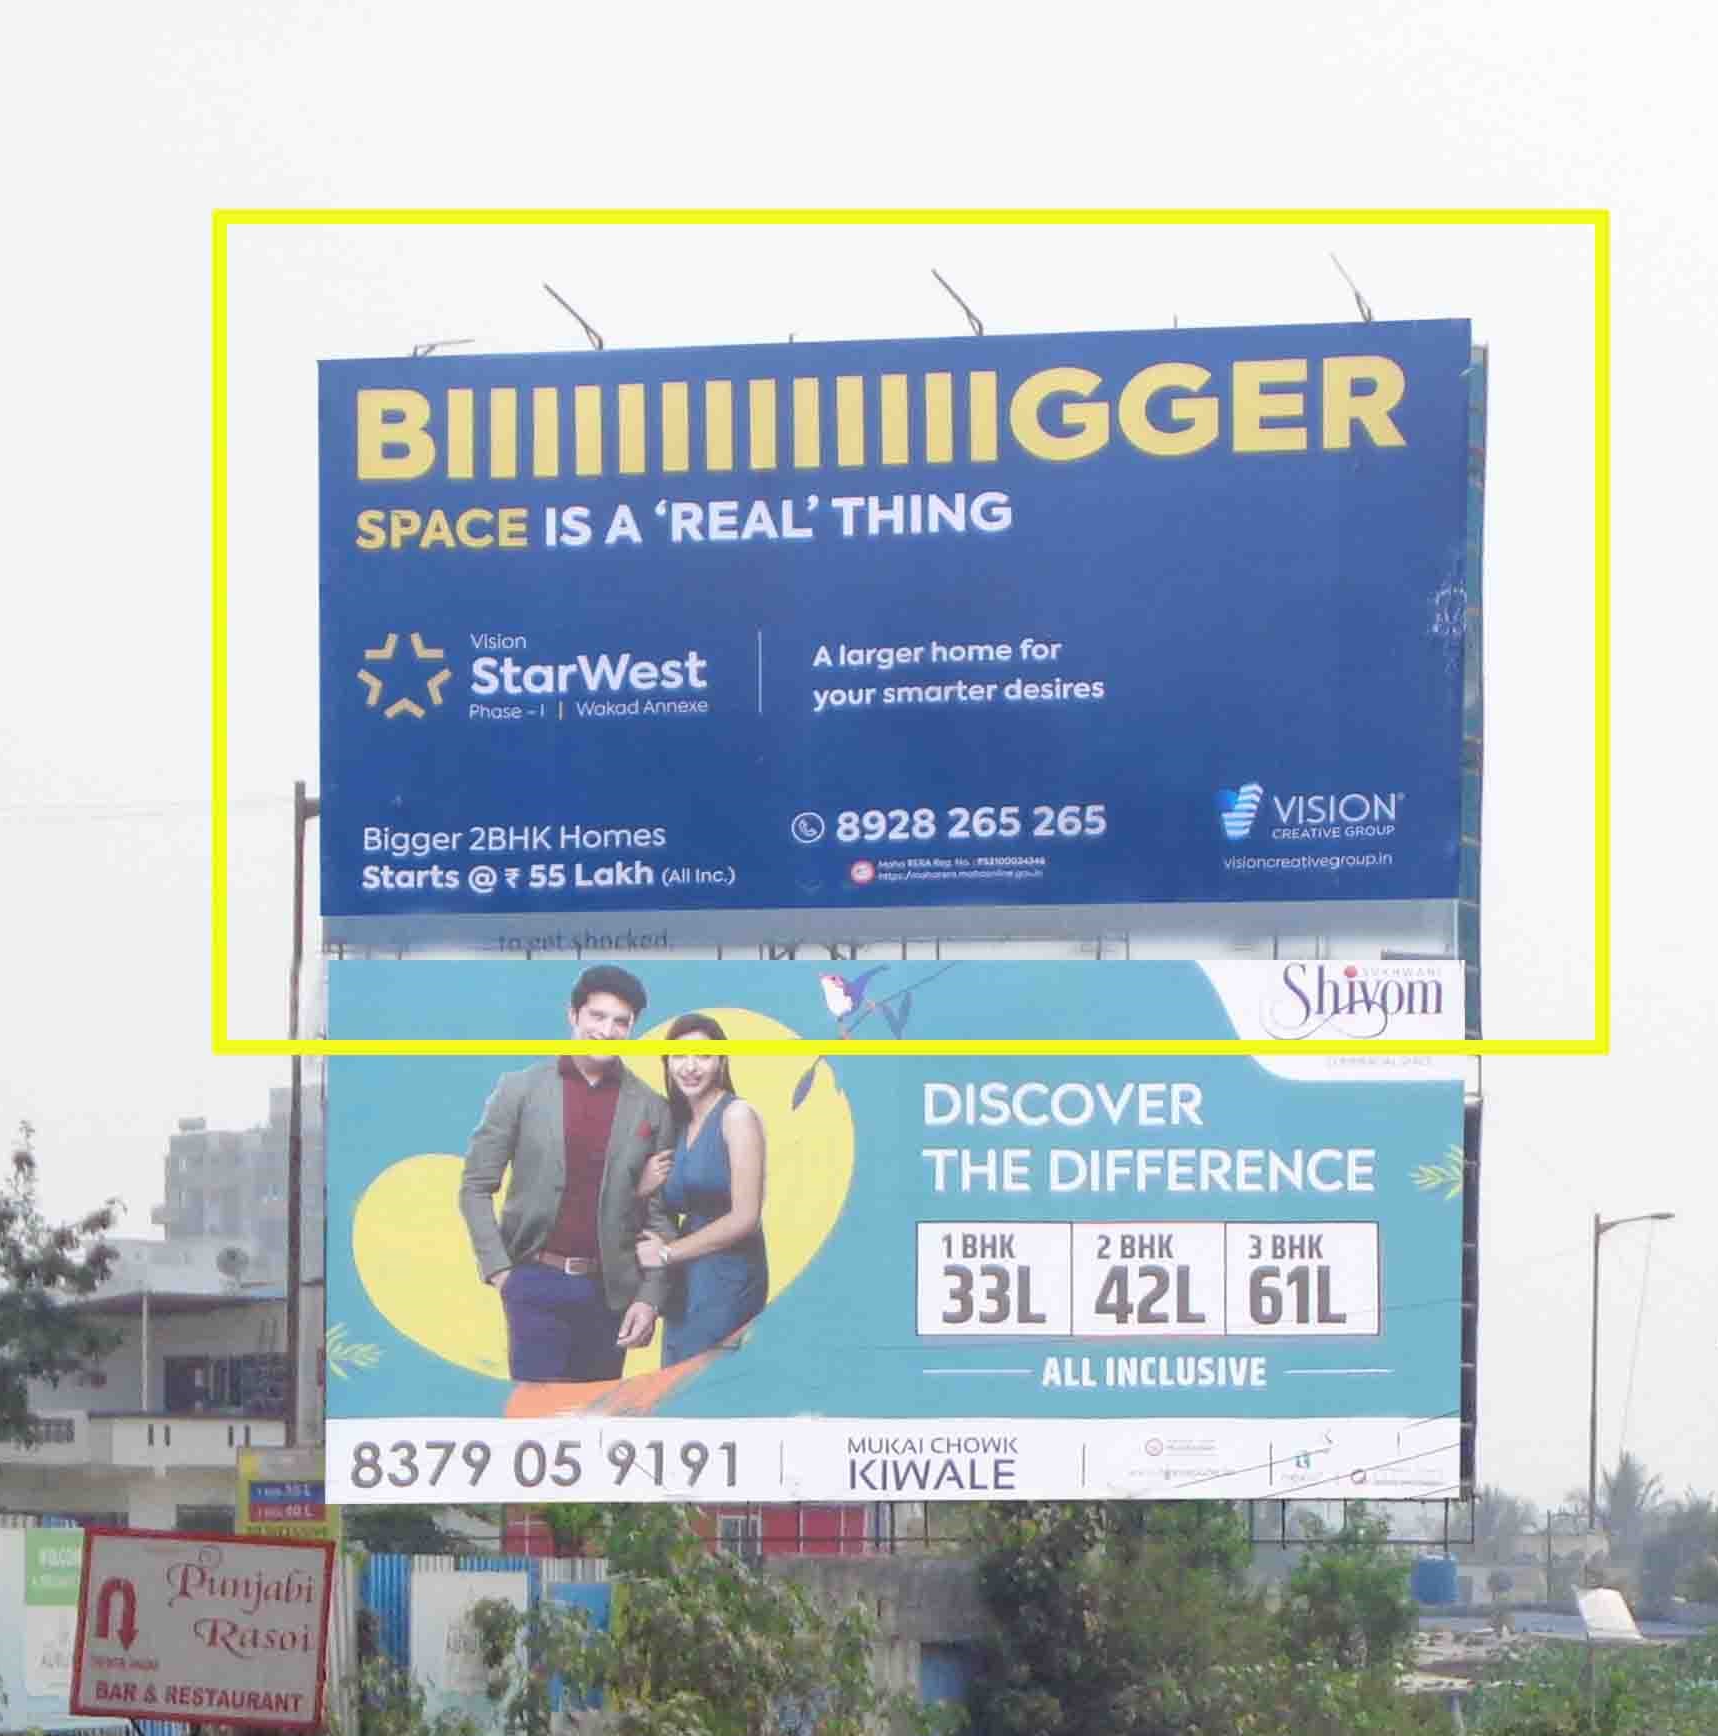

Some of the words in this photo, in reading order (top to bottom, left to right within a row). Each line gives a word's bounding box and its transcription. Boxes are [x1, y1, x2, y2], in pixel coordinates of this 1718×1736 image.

[355, 508, 529, 549] SPACE
[544, 505, 592, 547] IS
[604, 504, 643, 545] A
[831, 491, 1013, 539] THING
[470, 633, 527, 649] Vision
[813, 645, 832, 667] A
[839, 644, 924, 669] larger
[931, 640, 1012, 662] home
[1019, 638, 1063, 660] for
[471, 651, 708, 695] StarWest
[469, 703, 522, 719] Phase
[577, 700, 639, 717] Wakad
[643, 699, 709, 716] Annexe
[813, 687, 876, 712] your
[882, 679, 998, 704] smarter
[1004, 678, 1105, 700] desires
[836, 807, 937, 842] 8928
[947, 805, 1022, 839] 265
[1033, 802, 1108, 838] 265
[1273, 793, 1396, 824] VISION
[363, 826, 463, 857] Bigger
[468, 825, 552, 852] 2BHK
[560, 823, 667, 851] Homes
[1272, 826, 1340, 840] CREATIVE
[1344, 824, 1395, 838] GROUP
[362, 863, 459, 891] Starts
[467, 865, 497, 894] @
[529, 862, 566, 888] 55
[575, 859, 655, 887] Lakh
[661, 866, 691, 888] (All
[694, 865, 736, 887] Inc.)
[1224, 852, 1394, 870] visioncreativegroup.in
[1281, 961, 1444, 1027] Shivom
[923, 1082, 1204, 1126] DISCOVER
[921, 1147, 1032, 1193] THE
[1050, 1147, 1376, 1193] DIFFERENCE
[942, 1234, 952, 1260] 1
[962, 1233, 1015, 1260] BHK
[1097, 1234, 1111, 1260] 2
[1119, 1233, 1174, 1260] BHK
[1248, 1234, 1262, 1260] 3
[1271, 1233, 1324, 1260] BHK
[941, 1264, 1046, 1325] 33L
[1095, 1264, 1206, 1325] 42L
[1248, 1264, 1347, 1325] 61L
[1042, 1356, 1096, 1387] ALL
[1106, 1356, 1267, 1387] INCLUSIVE
[350, 1440, 492, 1488] 8379
[513, 1439, 581, 1487] 05
[607, 1438, 738, 1487] 9191
[847, 1437, 923, 1455] MUKAI
[931, 1437, 1019, 1455] CHOWK
[850, 1458, 1015, 1490] KIWALE
[166, 1546, 315, 1615] Punjabi
[193, 1617, 309, 1660] Rasoi
[94, 1681, 134, 1702] BAR
[144, 1683, 158, 1704] &
[166, 1685, 304, 1713] RESTAURANT
